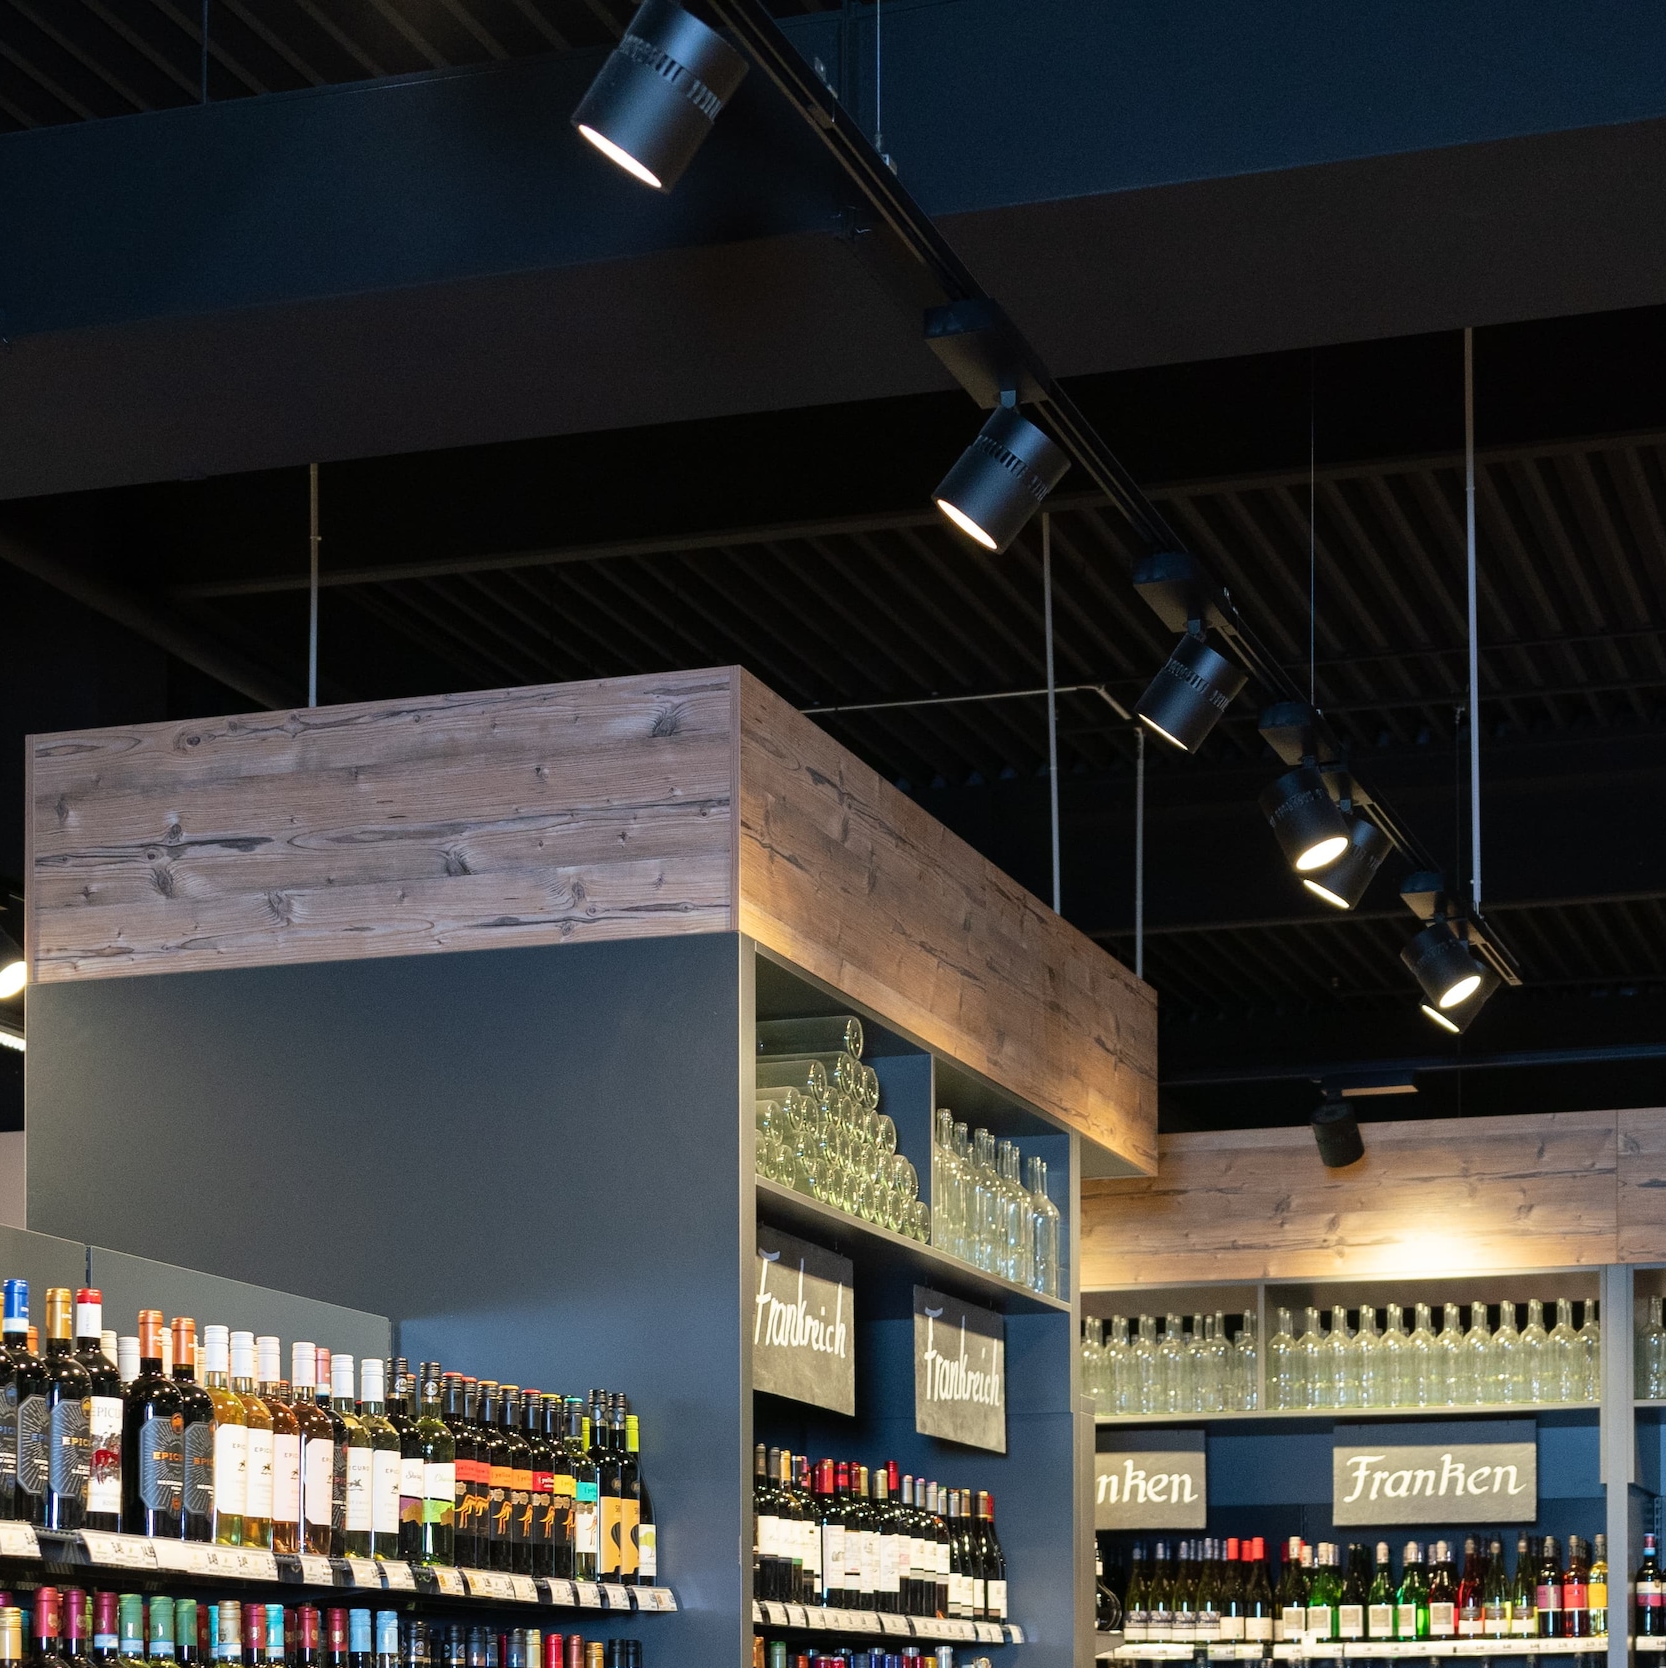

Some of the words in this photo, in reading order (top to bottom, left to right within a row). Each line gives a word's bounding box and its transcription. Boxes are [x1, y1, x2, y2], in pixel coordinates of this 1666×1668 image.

[755, 1247, 846, 1359] Frankreich
[923, 1307, 1001, 1407] Frankreich
[1097, 1459, 1199, 1505] nken
[1343, 1453, 1527, 1503] Franken
